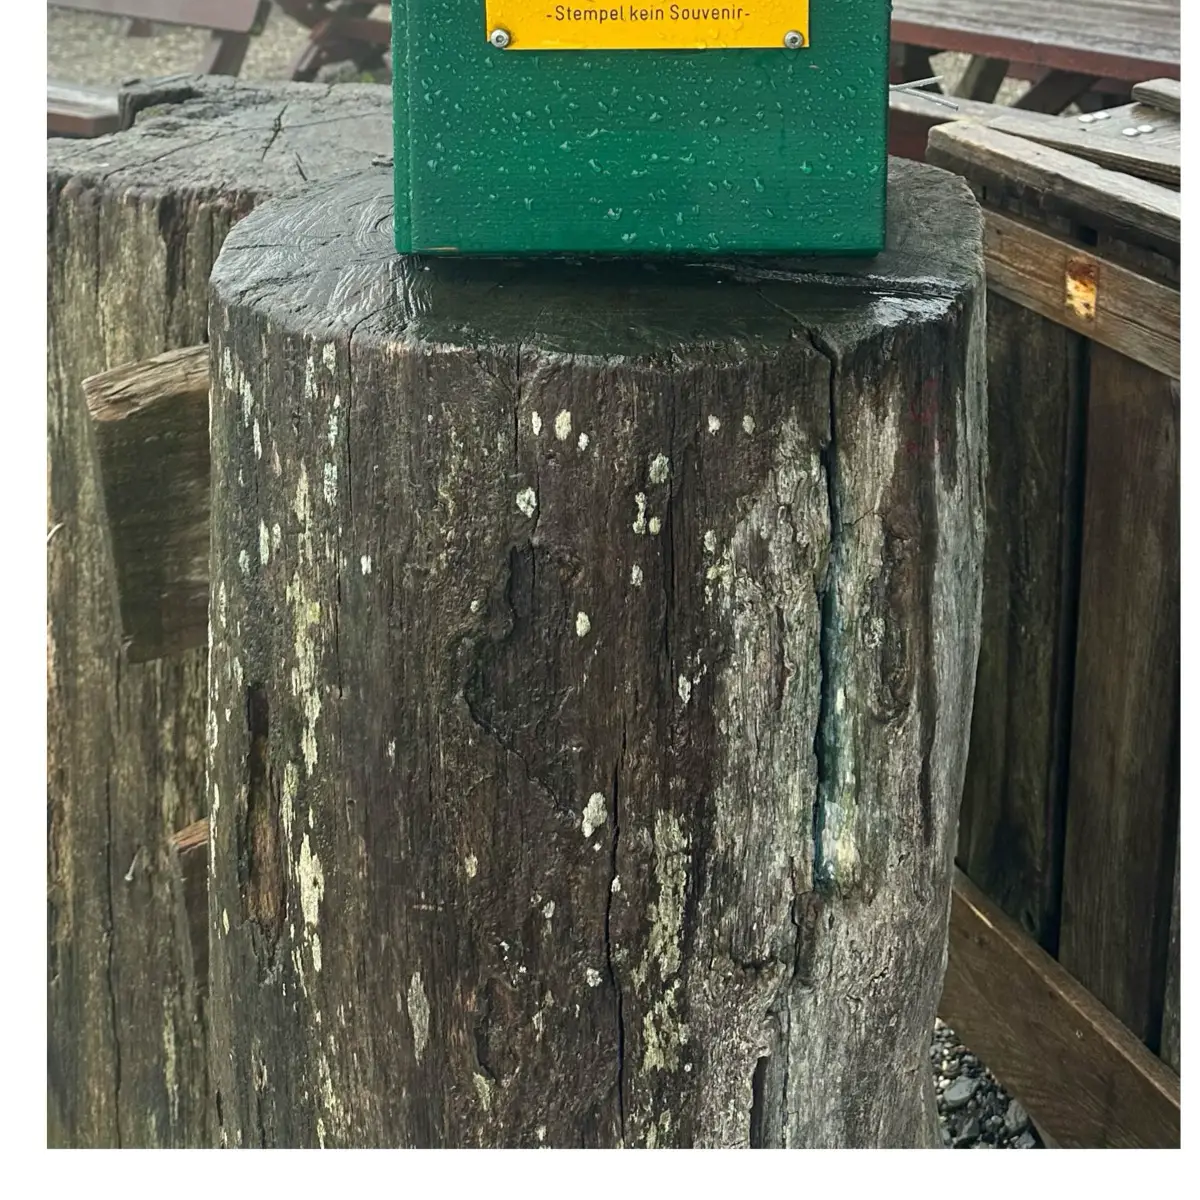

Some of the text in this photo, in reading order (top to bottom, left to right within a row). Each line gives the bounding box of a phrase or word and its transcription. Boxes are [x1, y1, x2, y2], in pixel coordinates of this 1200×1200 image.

[545, 3, 751, 24] -Stempel kein Souvenir-
